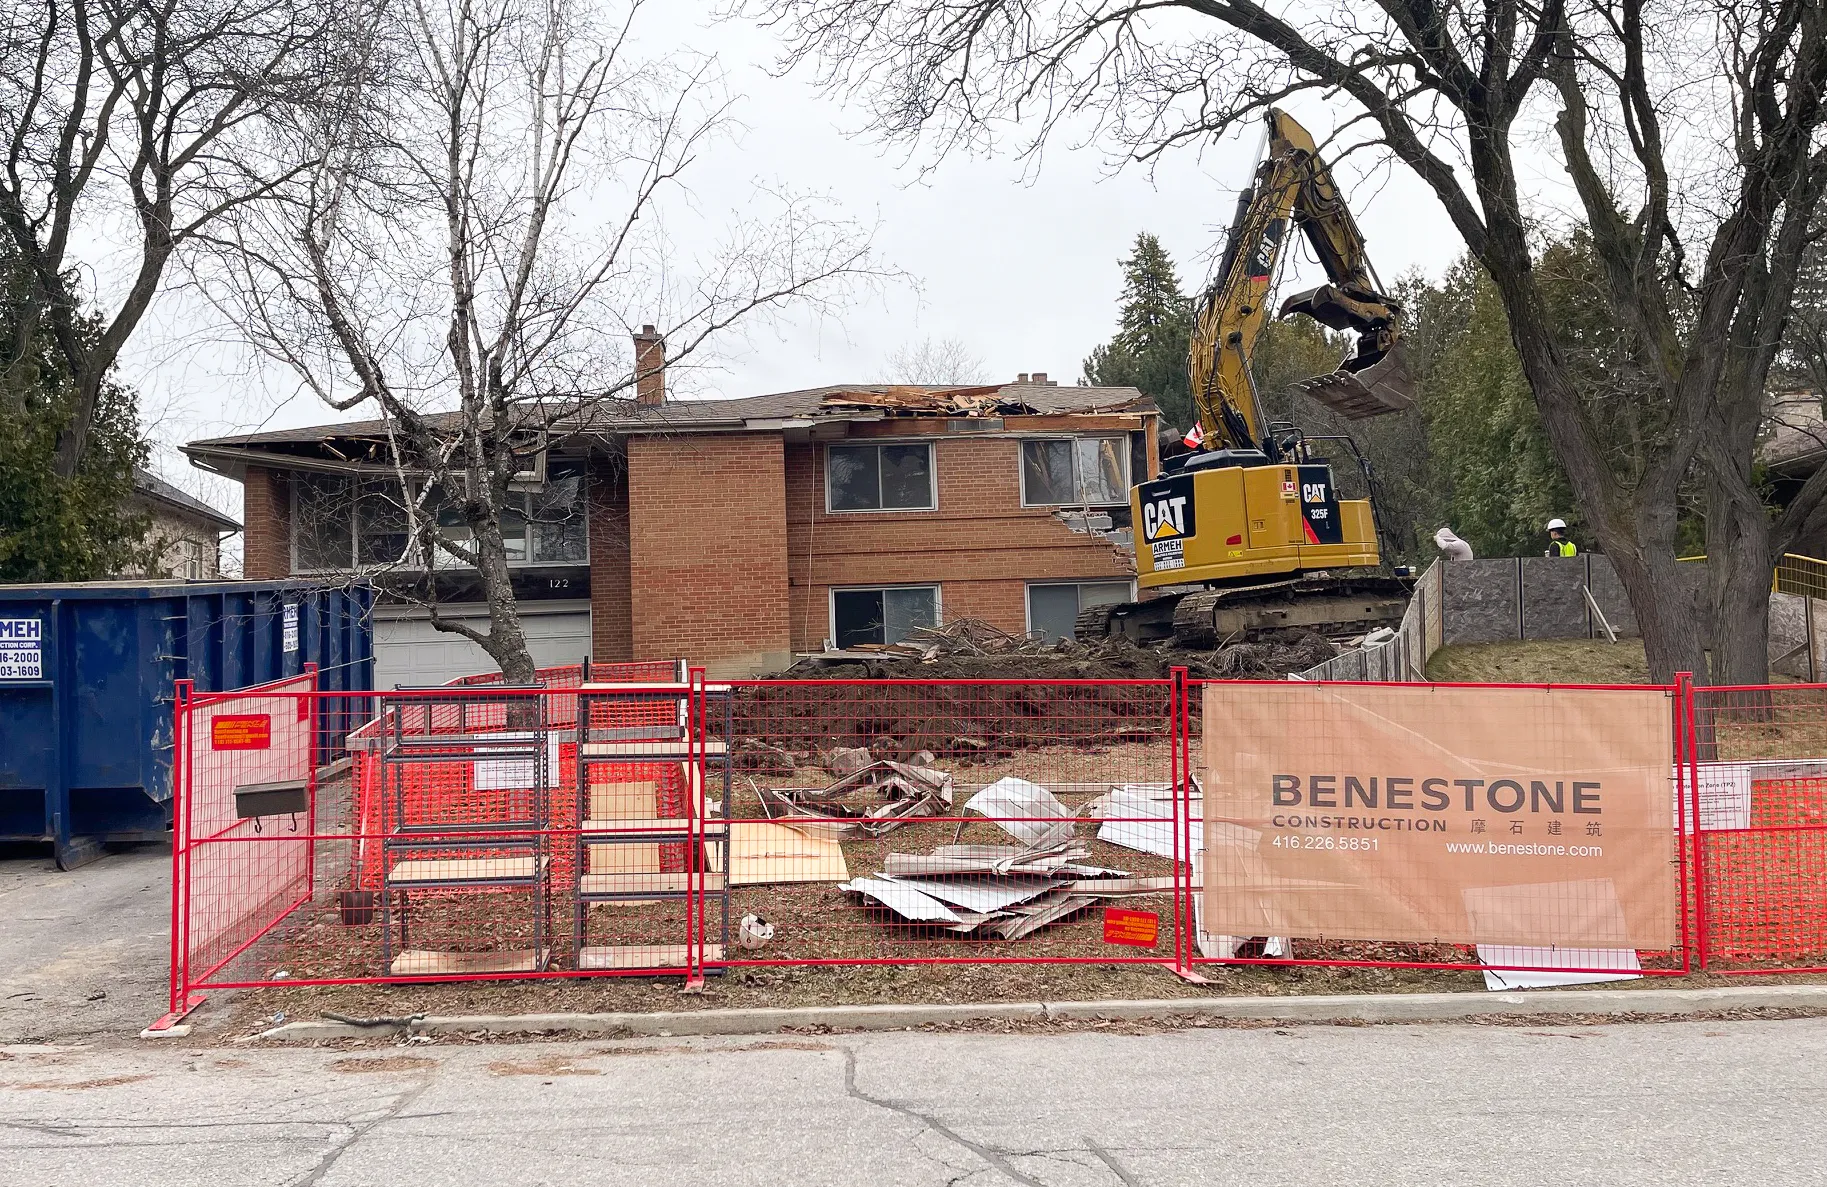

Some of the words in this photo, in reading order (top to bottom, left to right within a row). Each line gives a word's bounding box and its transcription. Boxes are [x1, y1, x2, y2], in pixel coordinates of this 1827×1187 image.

[1303, 483, 1326, 503] CAT
[1144, 496, 1187, 540] CAT
[1310, 508, 1328, 520] 325F
[1153, 540, 1182, 554] ARMEH
[550, 578, 569, 588] 122
[0, 665, 40, 677] 03-1609
[1272, 774, 1602, 815] BENESTONE
[1272, 815, 1446, 832] CONSTRUCTION
[1470, 818, 1603, 837] 摩石建筑
[1272, 835, 1378, 851] 416.226.5851
[1446, 841, 1603, 857] www.benestone.com
